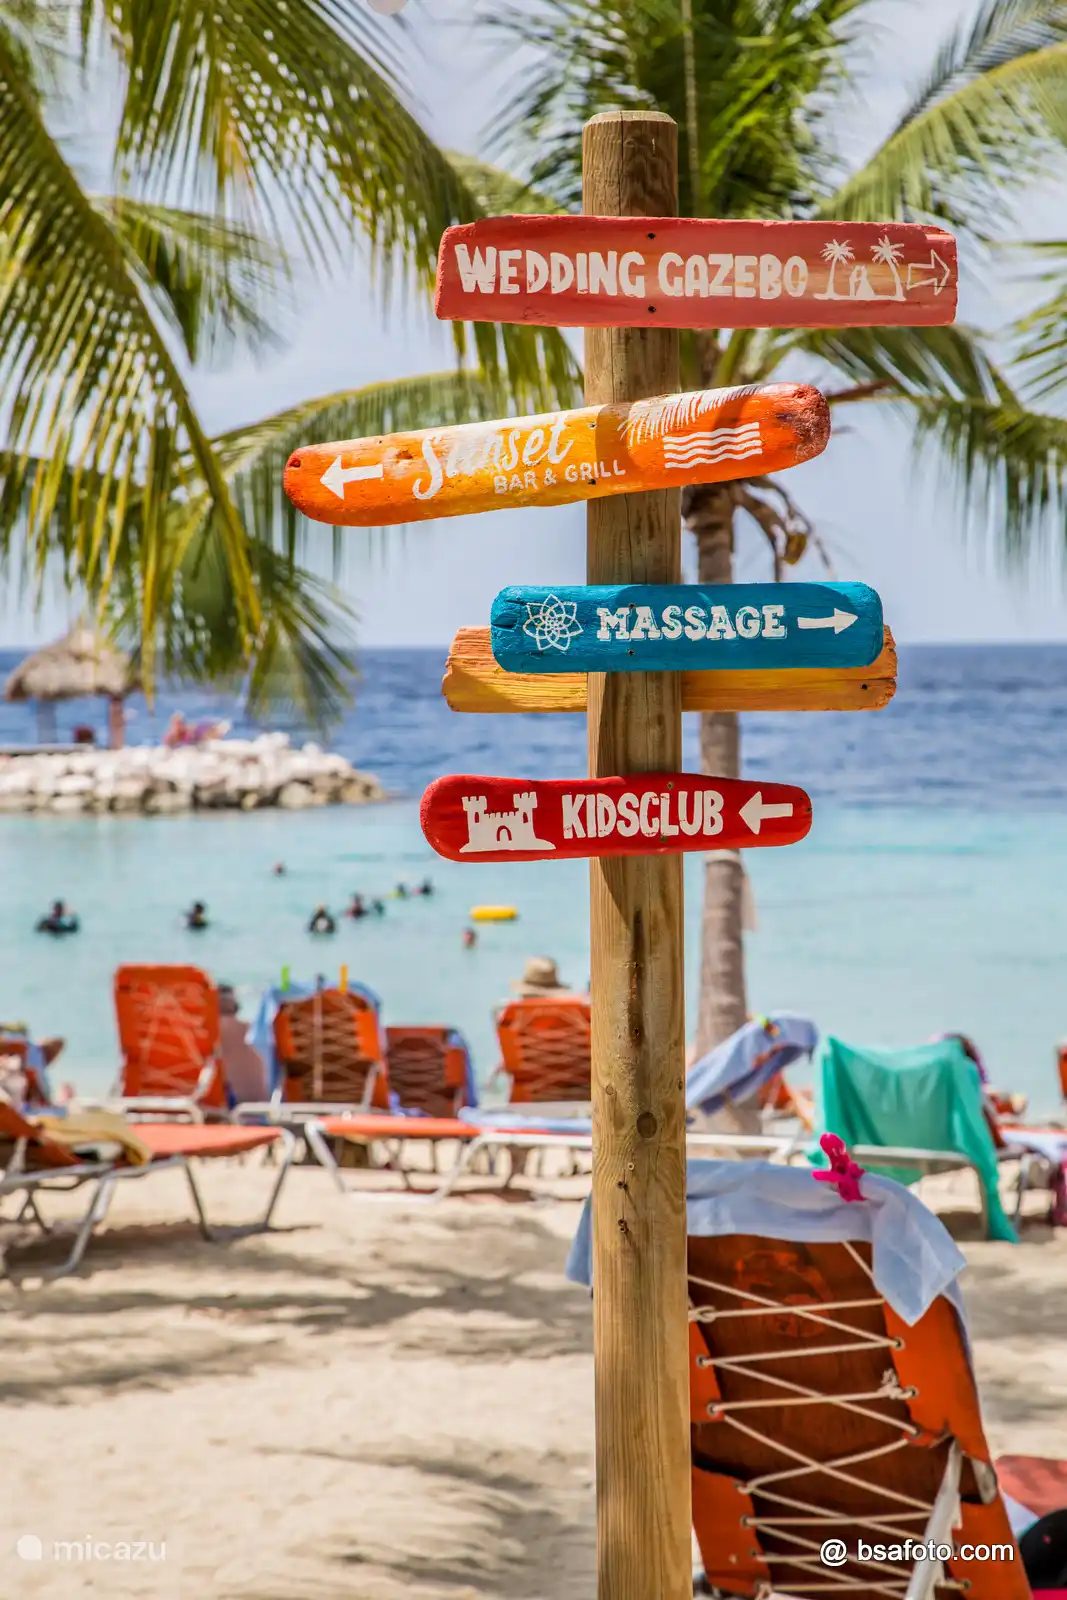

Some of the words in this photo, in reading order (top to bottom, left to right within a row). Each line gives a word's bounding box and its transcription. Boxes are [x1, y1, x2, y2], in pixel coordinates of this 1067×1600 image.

[455, 243, 645, 298] WEDDING
[657, 252, 808, 299] GAZEBO
[412, 412, 575, 500] Sunset
[494, 472, 538, 495] BAR
[543, 469, 557, 486] &
[565, 458, 626, 482] GRILL
[596, 605, 788, 642] MASSAGE
[562, 790, 724, 840] KIDSCLUB
